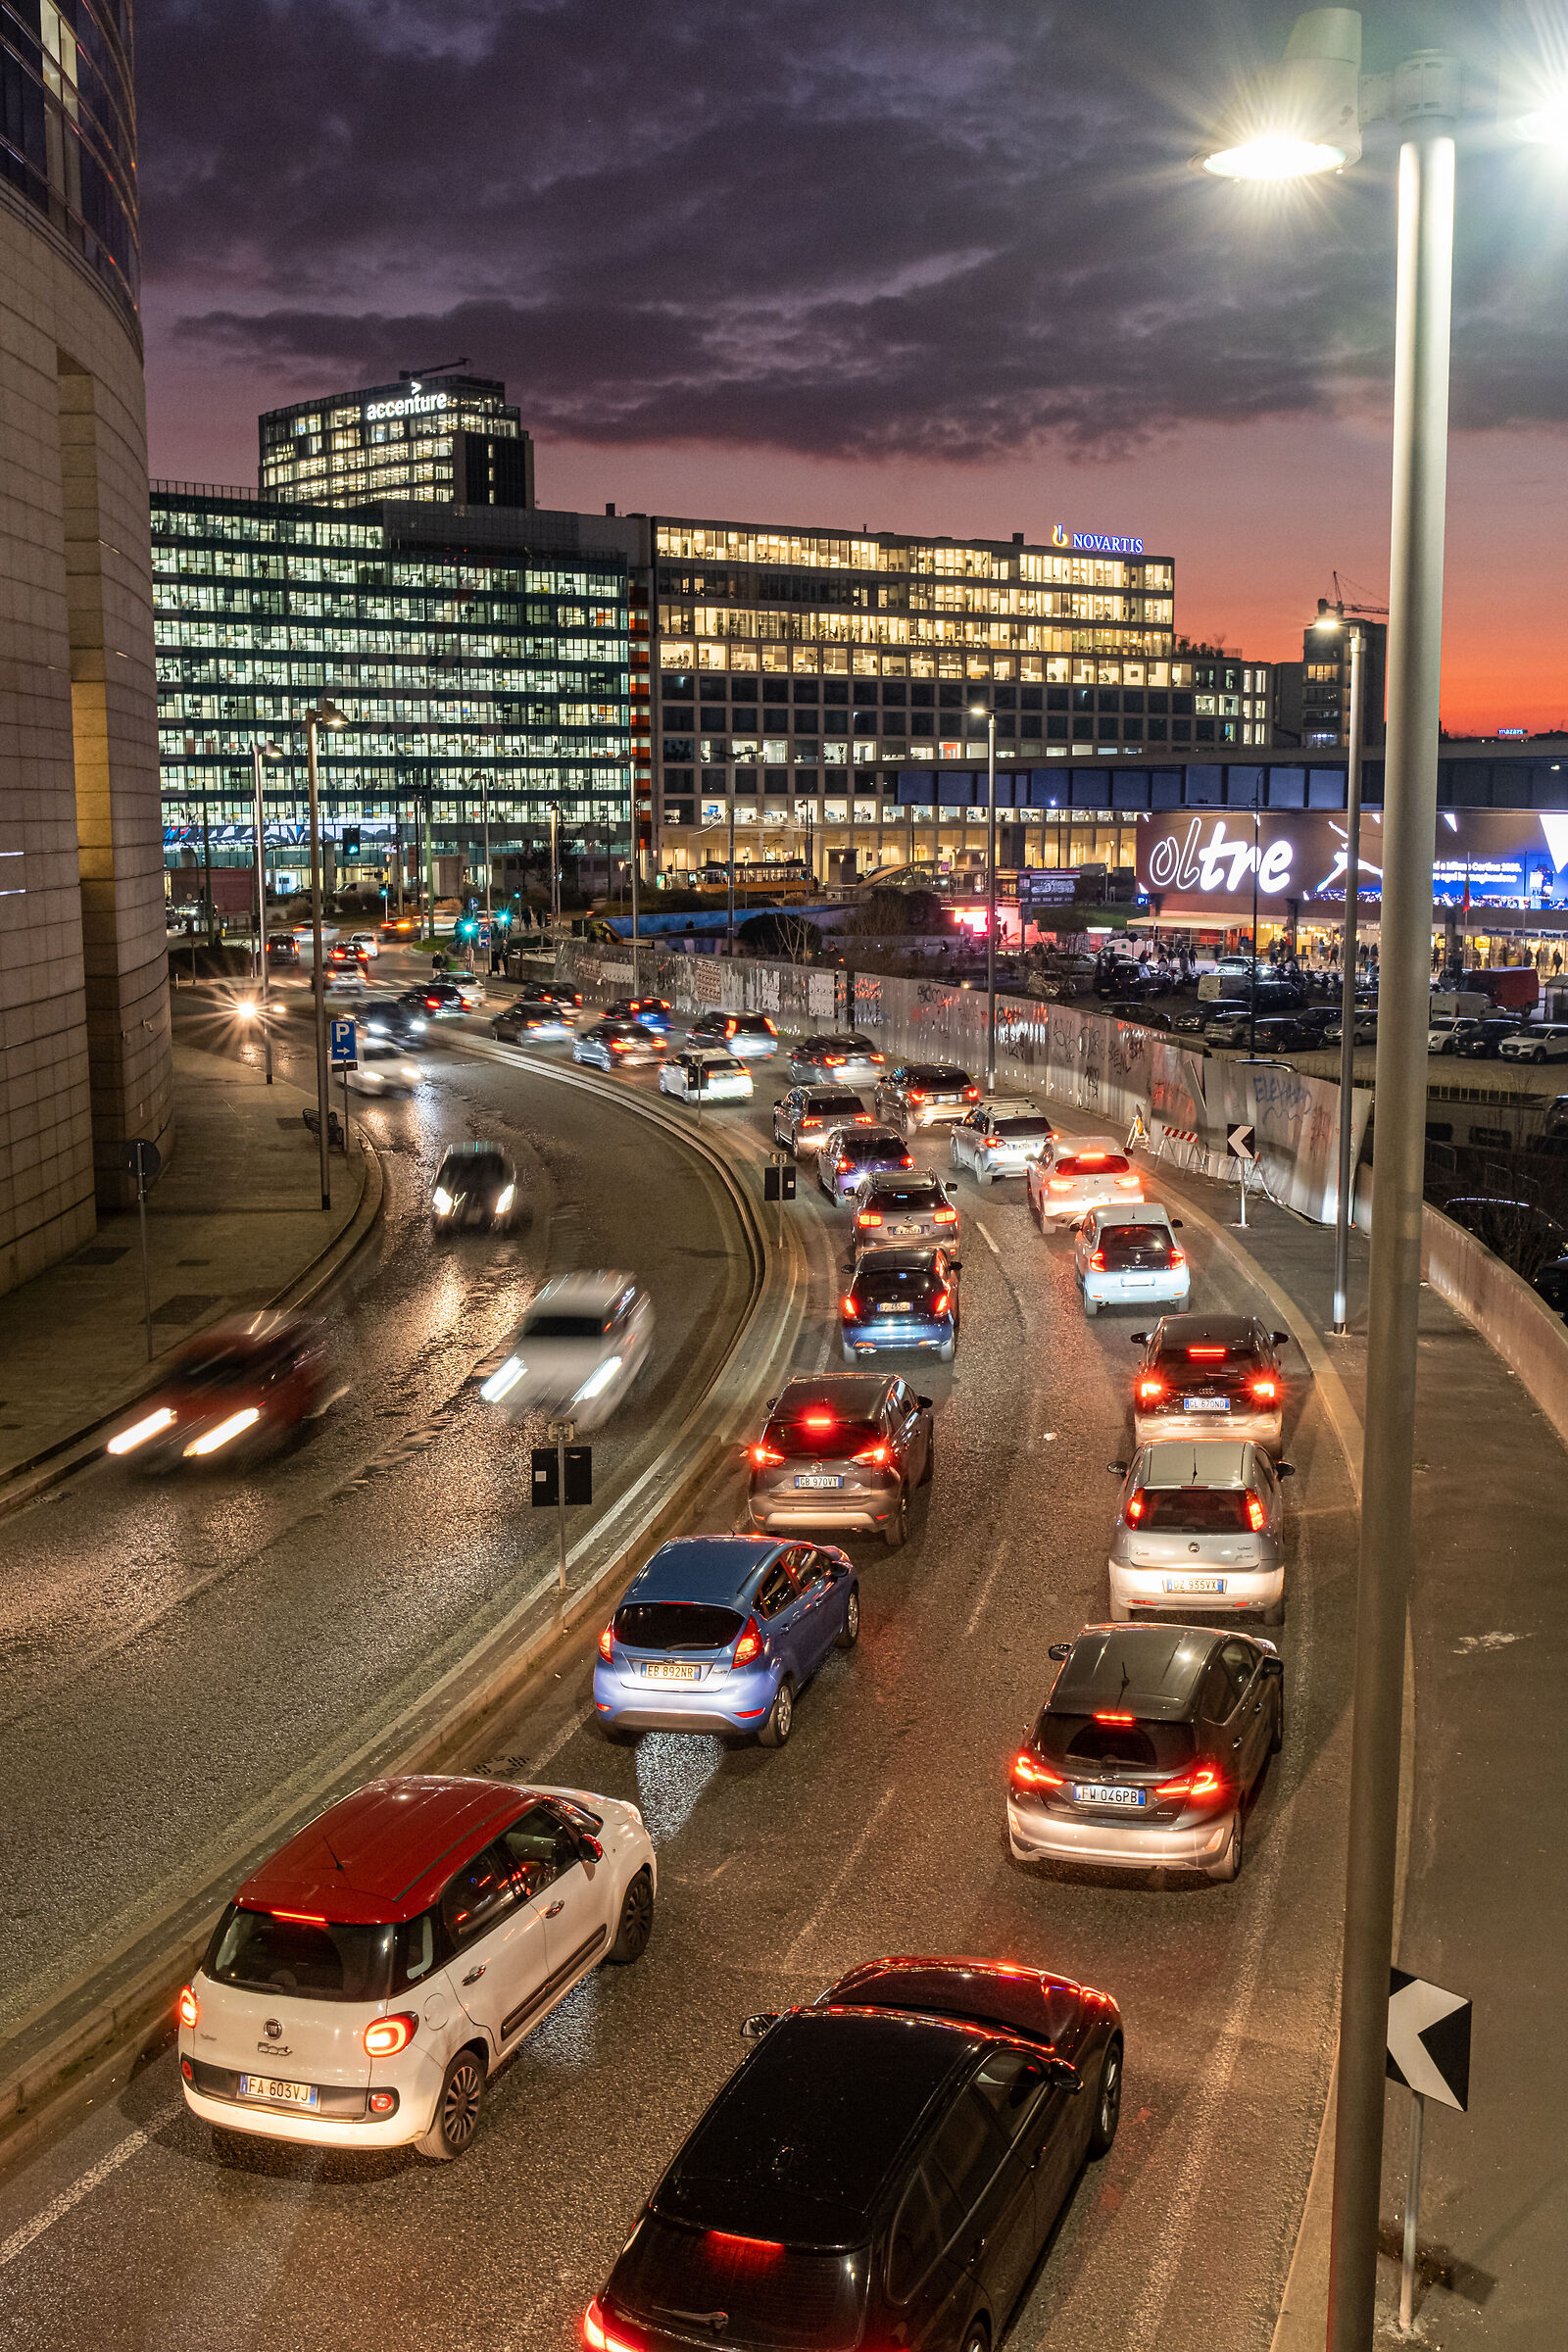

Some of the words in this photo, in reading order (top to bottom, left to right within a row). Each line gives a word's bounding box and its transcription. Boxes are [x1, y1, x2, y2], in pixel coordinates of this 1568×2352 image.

[367, 393, 448, 421] accenture
[1072, 533, 1144, 554] NOVARTIS
[1149, 816, 1294, 894] oltre
[335, 1022, 350, 1043] P
[1173, 1579, 1185, 1591] DZ
[1188, 1579, 1217, 1591] 935VX
[647, 1665, 660, 1677] EB
[662, 1666, 694, 1679] 892NR
[1081, 1786, 1097, 1800] FW
[1100, 1788, 1138, 1803] 046PB
[248, 2078, 265, 2095] FA
[269, 2081, 310, 2102] 603VJ
